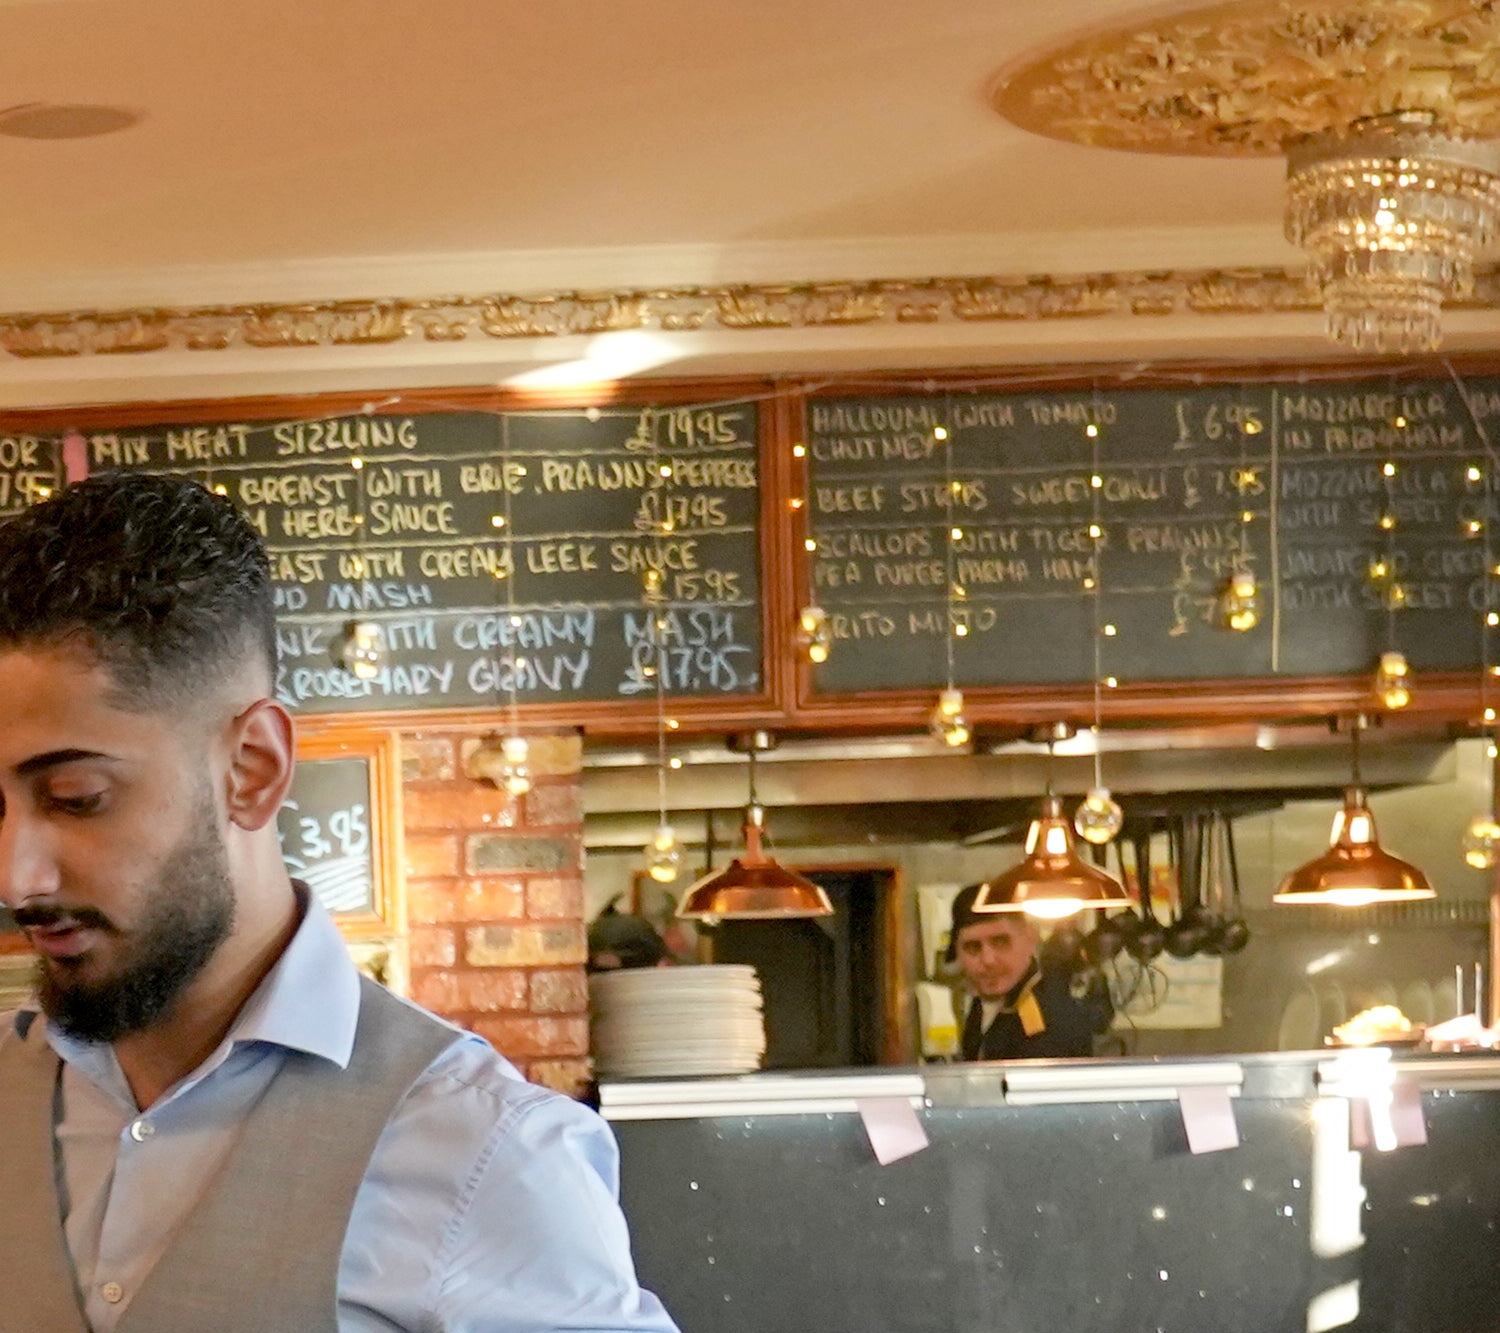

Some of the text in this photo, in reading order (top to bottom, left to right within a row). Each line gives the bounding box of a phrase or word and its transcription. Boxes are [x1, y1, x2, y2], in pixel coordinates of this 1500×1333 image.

[813, 404, 939, 432] HALLOUMI
[953, 403, 1015, 429] WITH
[1026, 401, 1117, 425] TOMATO
[167, 425, 249, 460] MEAT
[274, 419, 418, 455] SIZZLING
[812, 432, 938, 461] CHUTNEY
[1284, 427, 1312, 449] IN
[239, 473, 356, 506] BREAST
[367, 467, 442, 499] WITH
[816, 485, 884, 513] BEEF
[282, 506, 356, 538] HERB
[370, 500, 458, 535] SAUCE
[817, 529, 932, 558] SCALLOPS
[952, 529, 1018, 553] WITH
[339, 549, 406, 580] WITH
[526, 544, 598, 573] LEEK
[610, 541, 698, 572] SAUCE
[815, 561, 861, 587] PEA
[327, 581, 433, 610] MASH
[453, 610, 595, 650] CREAMY
[624, 608, 734, 648] MASH
[831, 611, 895, 639] RITO
[293, 661, 453, 699] ROSEMARY
[468, 650, 589, 693] GRAVY
